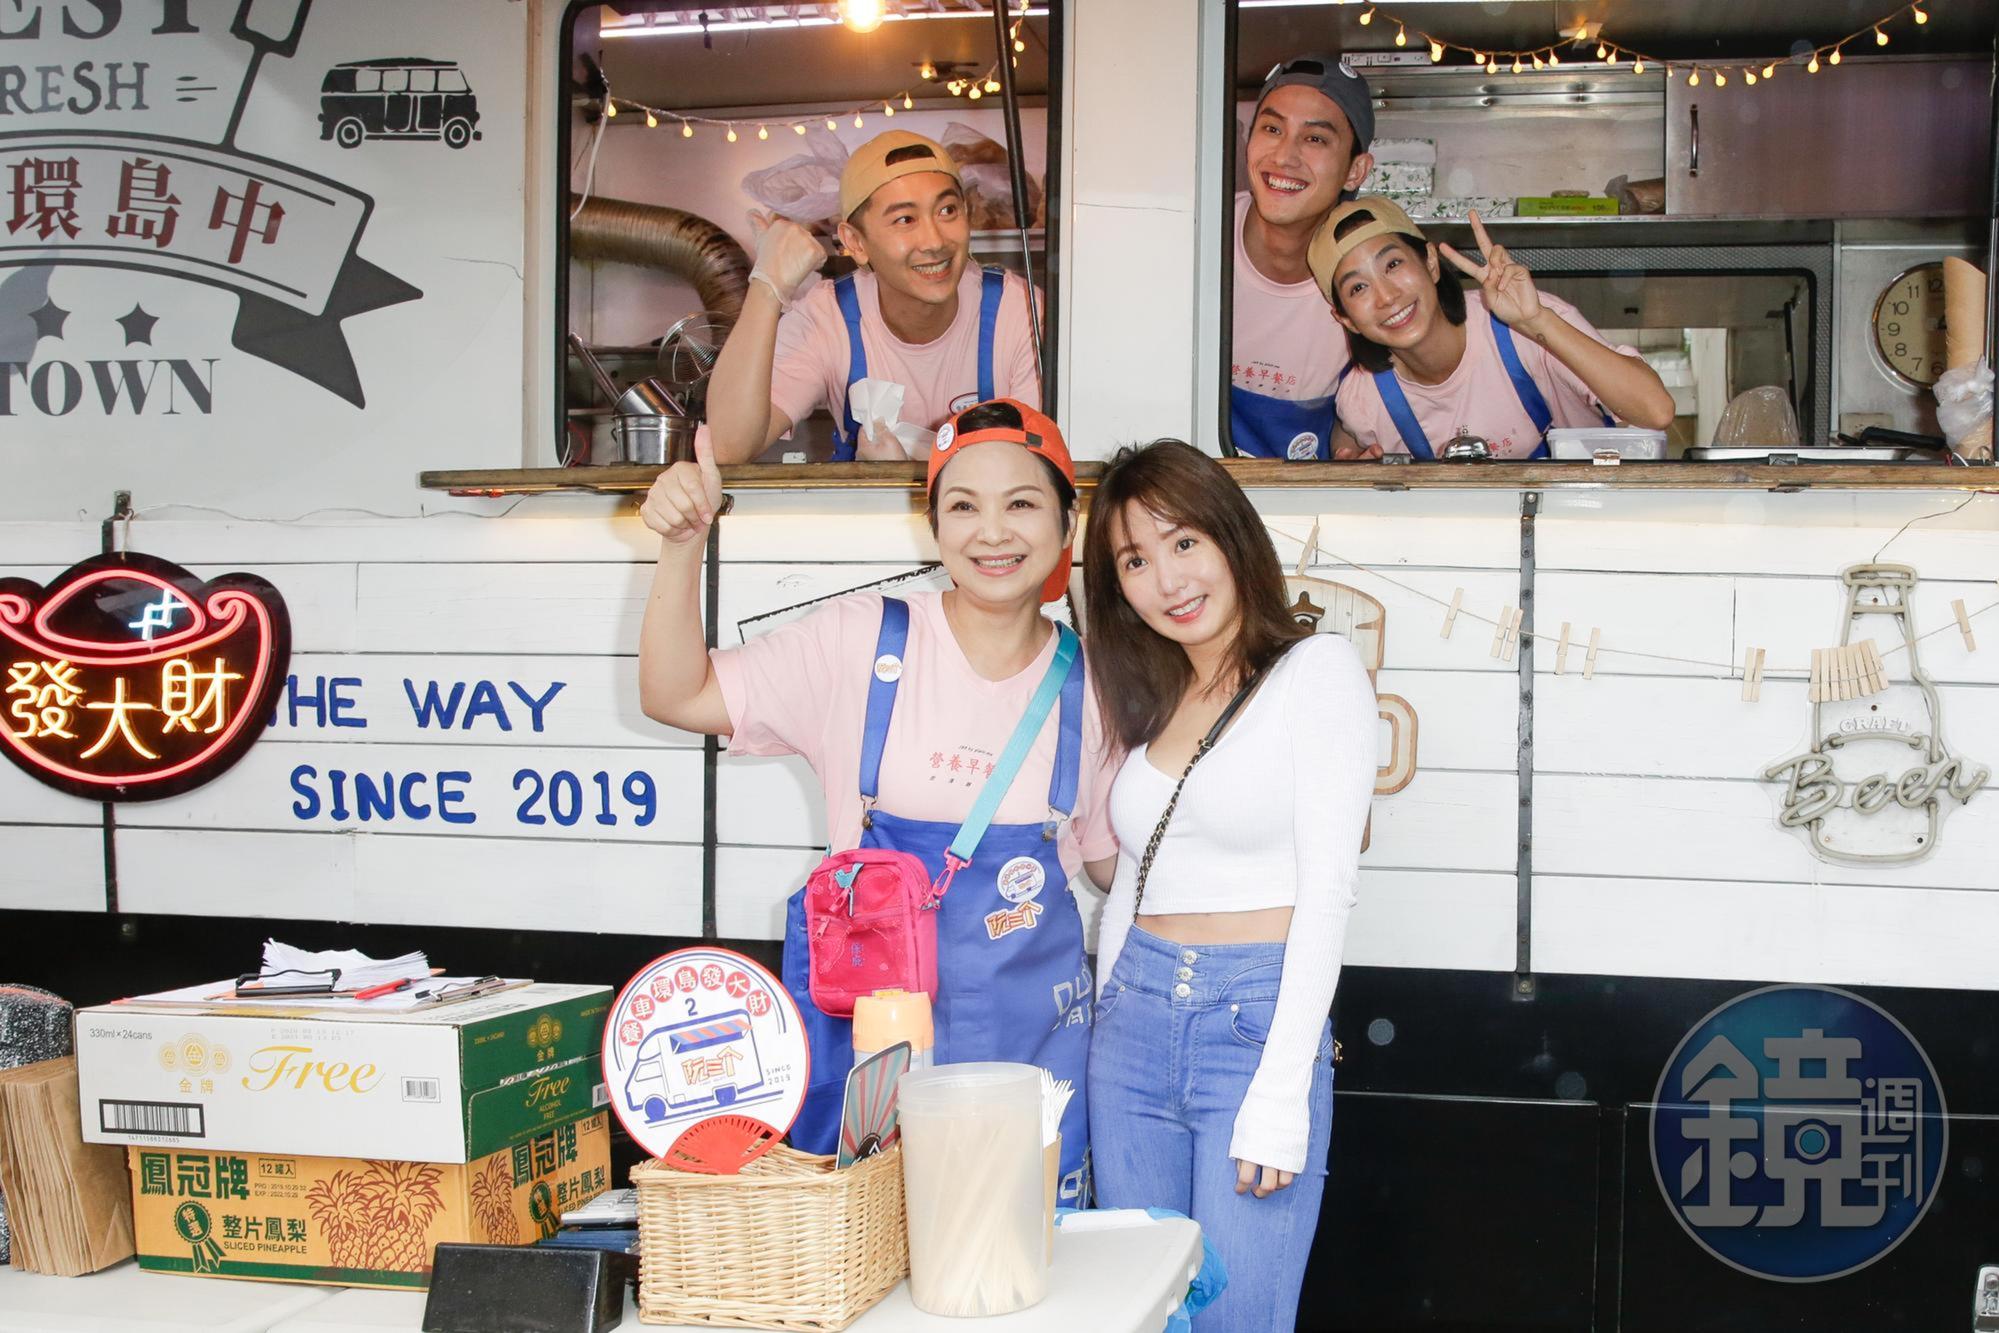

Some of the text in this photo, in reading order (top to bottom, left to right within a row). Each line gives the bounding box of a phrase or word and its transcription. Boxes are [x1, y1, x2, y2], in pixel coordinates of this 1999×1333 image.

[6, 156, 285, 263] 環島中
[1908, 285, 1919, 299] 11
[1892, 302, 1909, 315] 10
[1887, 322, 1900, 336] 9
[1894, 343, 1907, 357] 8
[1911, 357, 1922, 371] 7
[6, 657, 243, 760] 發大財
[268, 674, 567, 732] HE WAY
[1839, 716, 1911, 732] CRAFT
[289, 763, 658, 827] SINCE 2019
[1764, 752, 1989, 827] Beer
[684, 997, 699, 1016] 2
[242, 1045, 385, 1095] Free
[526, 1076, 570, 1108] Free
[261, 1163, 273, 1174] 12
[222, 1215, 308, 1243] 整片鳳梨
[223, 1241, 309, 1255] SLICED PINEAPPLE
